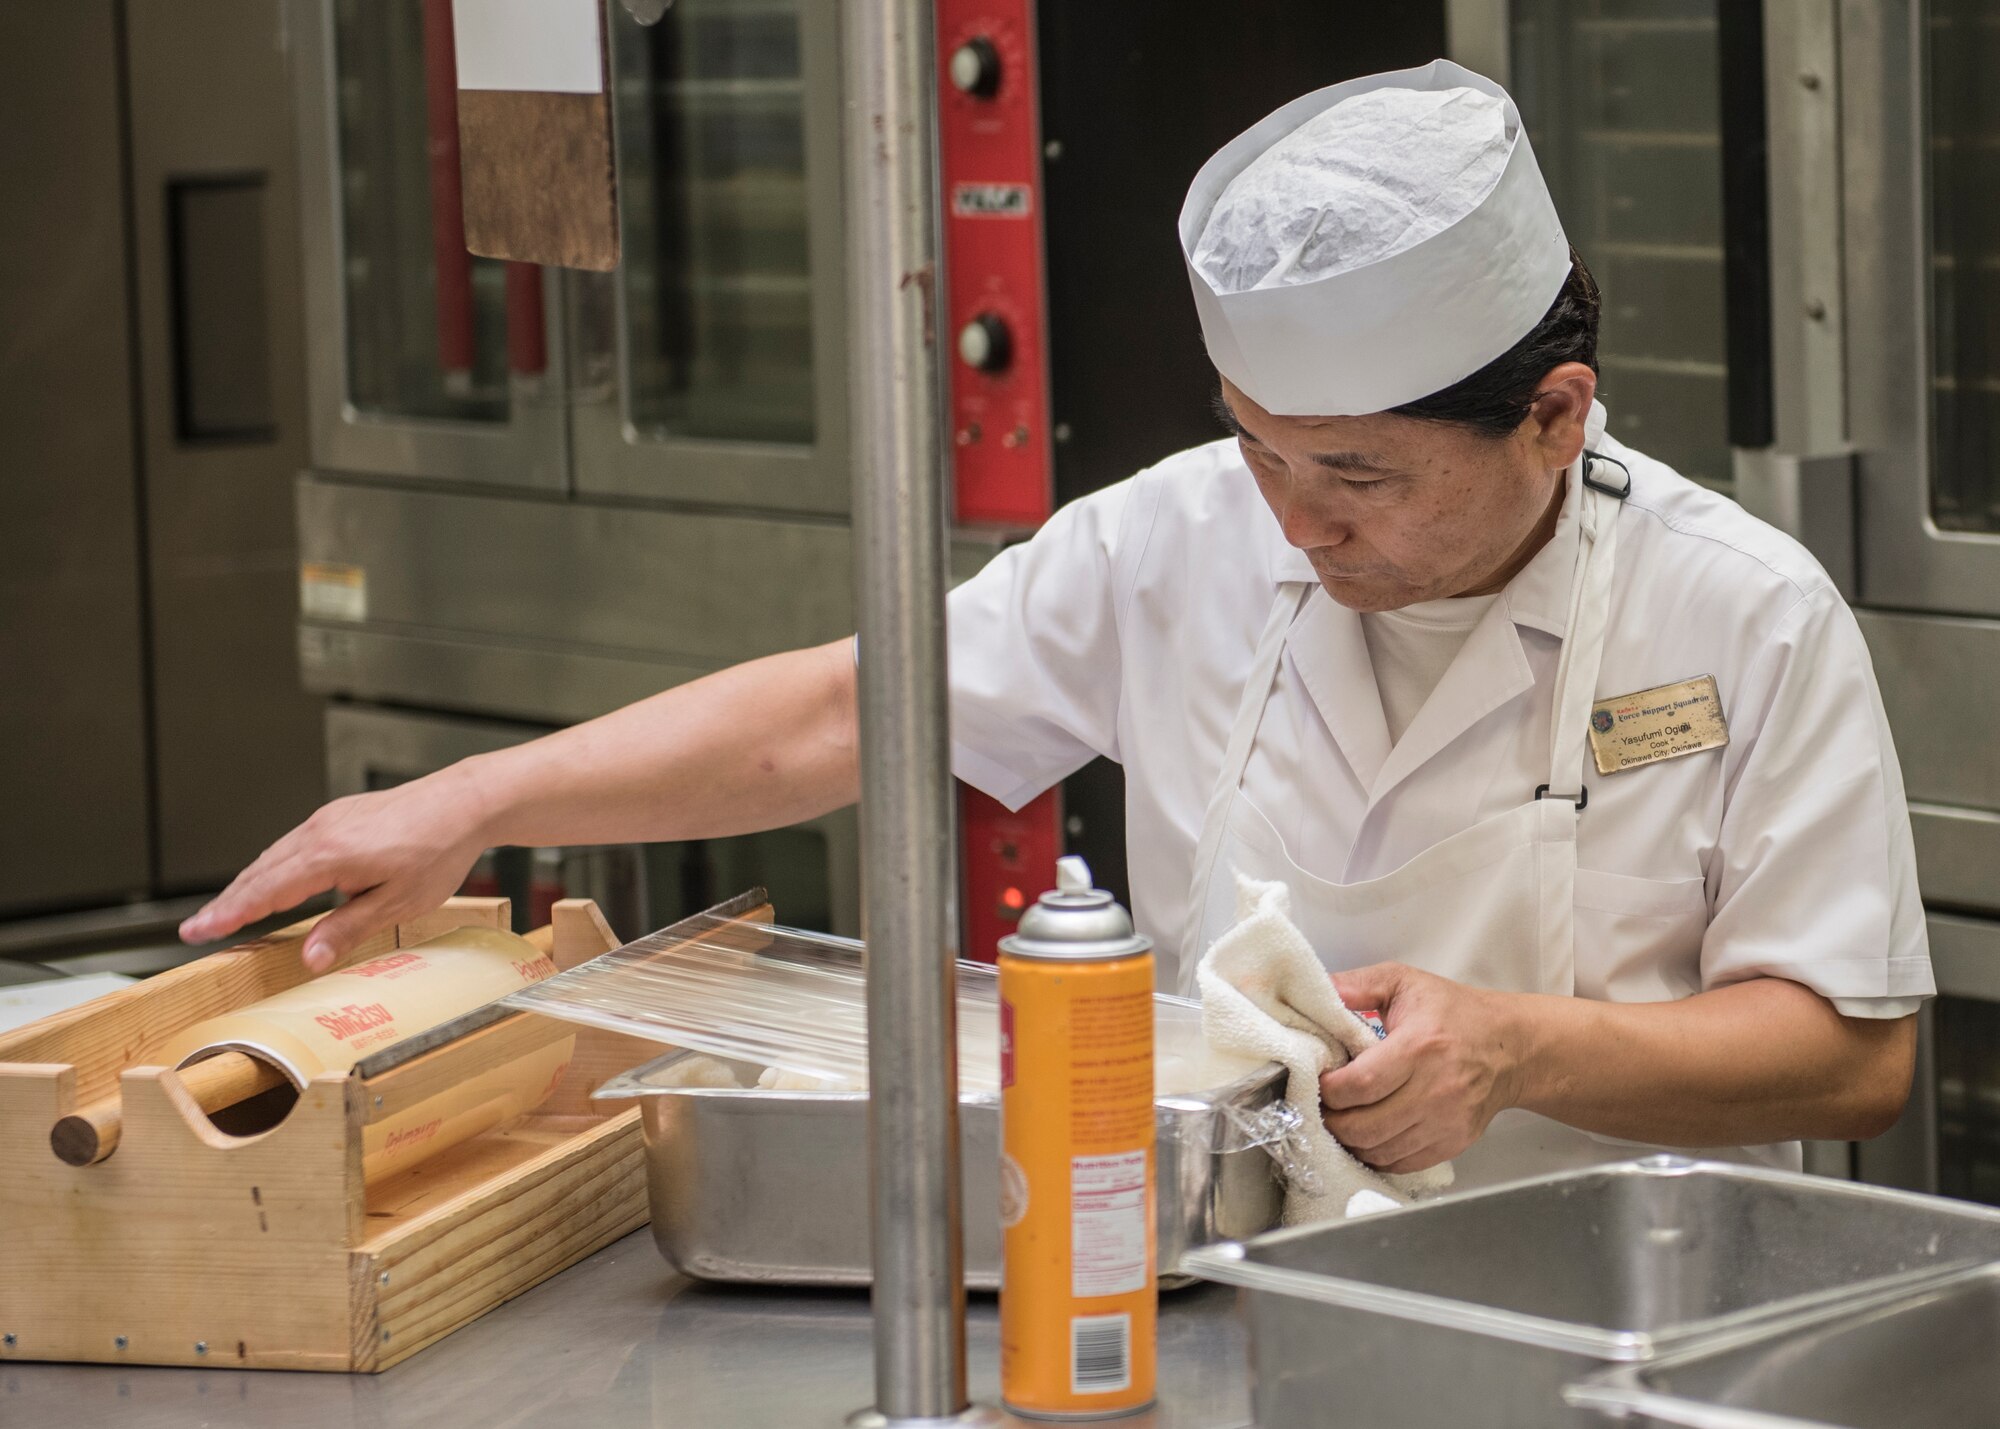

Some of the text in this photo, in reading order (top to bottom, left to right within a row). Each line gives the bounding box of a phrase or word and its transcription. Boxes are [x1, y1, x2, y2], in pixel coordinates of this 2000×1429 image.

[1618, 695, 1709, 722] Force Support Squadron
[1620, 721, 1692, 746] Yasufumi Ogimi
[1649, 740, 1670, 749] Cook
[1620, 740, 1702, 766] Okinawa City, Okinawa
